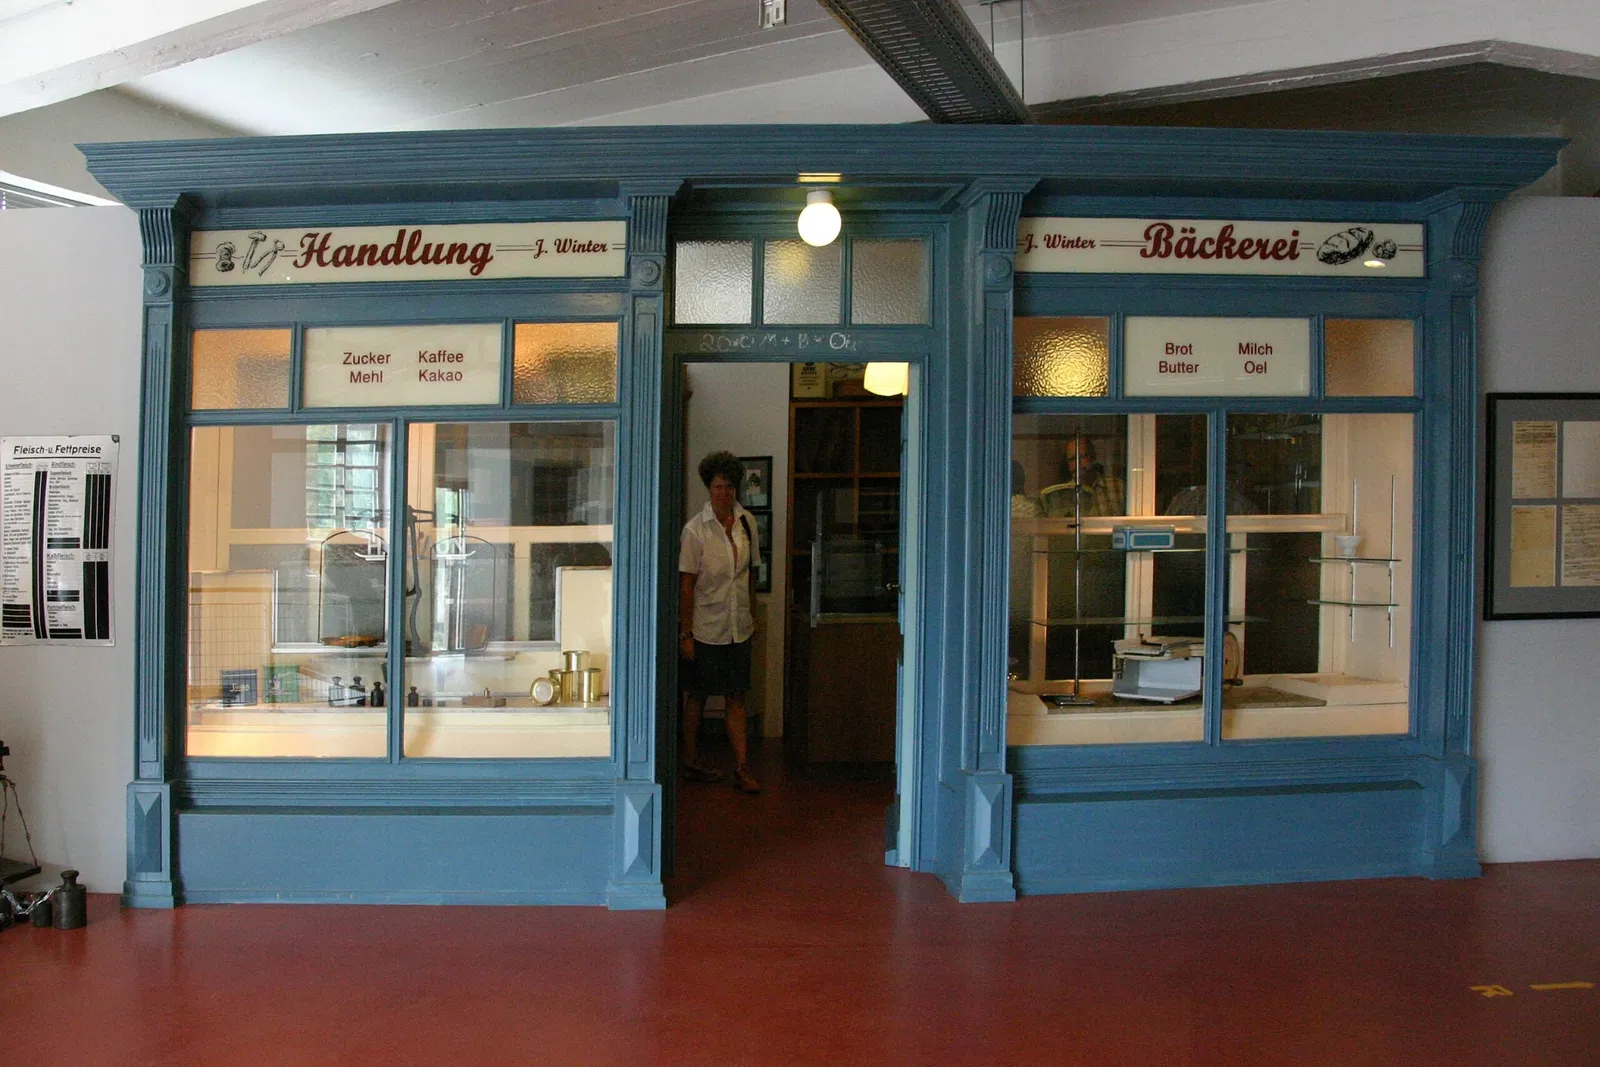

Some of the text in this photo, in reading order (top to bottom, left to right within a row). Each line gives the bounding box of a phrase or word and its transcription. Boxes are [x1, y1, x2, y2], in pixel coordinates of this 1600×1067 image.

[1024, 222, 1300, 260] J. Winter Bäckerei
[293, 229, 607, 276] Handlung J. Winter
[1165, 343, 1193, 355] Brot
[1238, 343, 1273, 355] Milch
[343, 352, 391, 365] Zucker
[418, 351, 464, 363] Kaffee
[1158, 361, 1199, 374] Butter
[1244, 361, 1267, 374] Oel
[350, 371, 383, 383] Mehl
[418, 370, 463, 382] Kakao
[55, 445, 102, 455] Fettpreise
